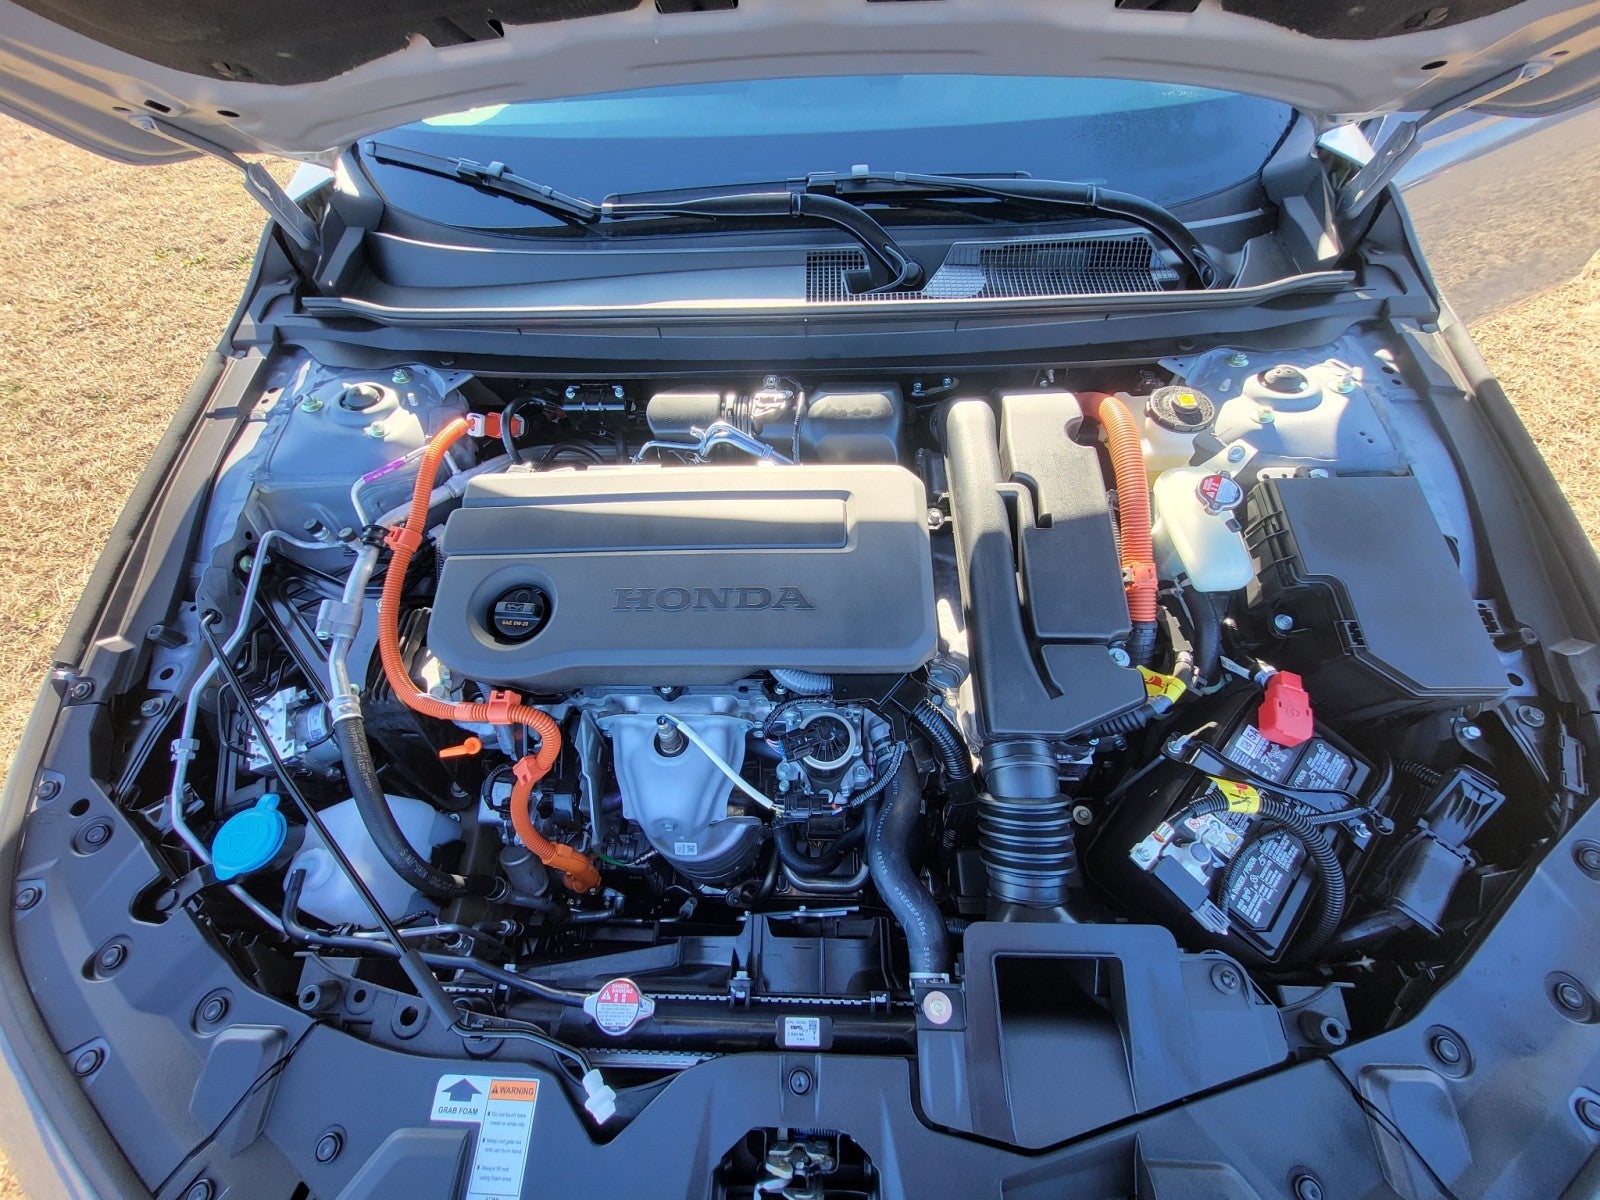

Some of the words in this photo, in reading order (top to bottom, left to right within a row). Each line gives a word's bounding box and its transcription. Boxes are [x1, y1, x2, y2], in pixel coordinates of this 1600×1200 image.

[611, 586, 815, 612] HONDA
[499, 1086, 534, 1095] WARNING
[438, 1106, 457, 1115] GRAB
[459, 1107, 479, 1116] FOAM
